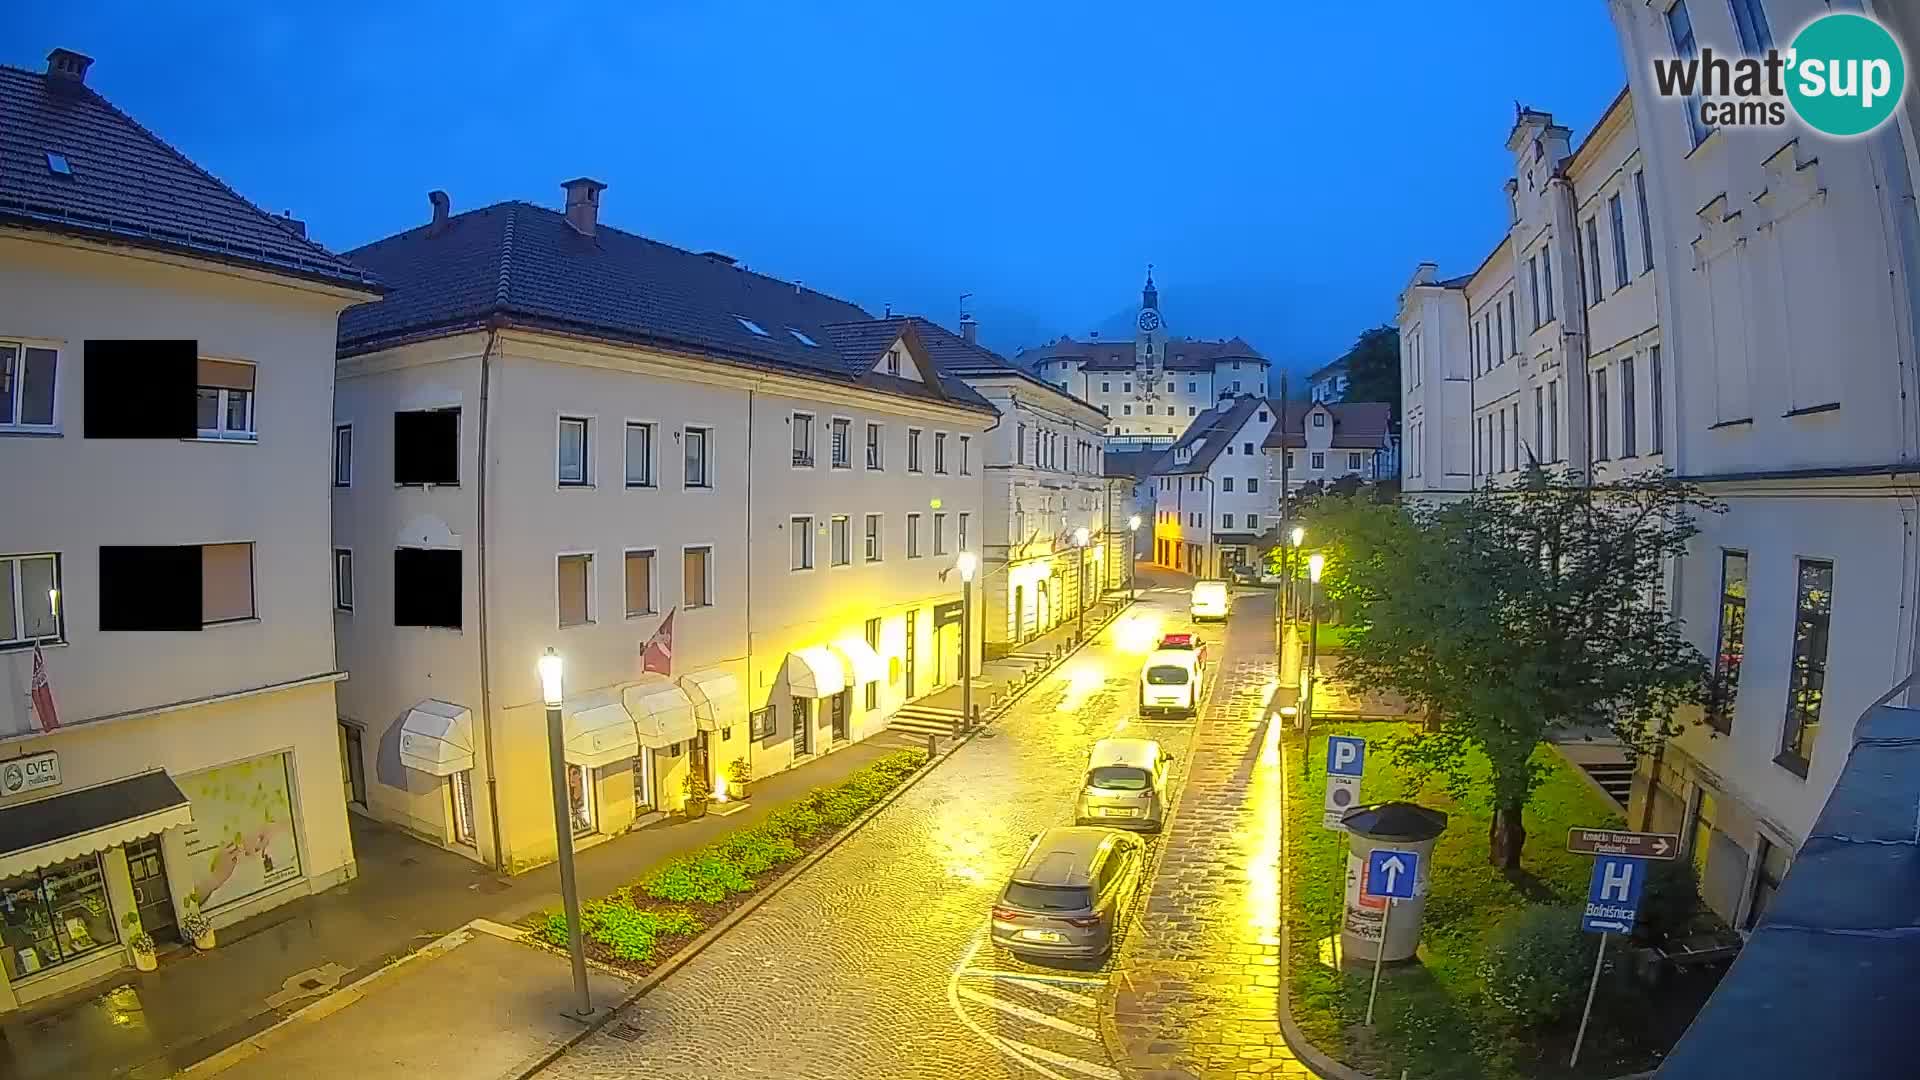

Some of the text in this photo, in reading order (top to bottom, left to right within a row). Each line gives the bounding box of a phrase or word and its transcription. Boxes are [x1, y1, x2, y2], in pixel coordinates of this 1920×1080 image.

[26, 758, 55, 776] CVET
[1334, 741, 1356, 770] P
[1600, 862, 1633, 901] H
[1585, 903, 1635, 920] Bolnišnica
